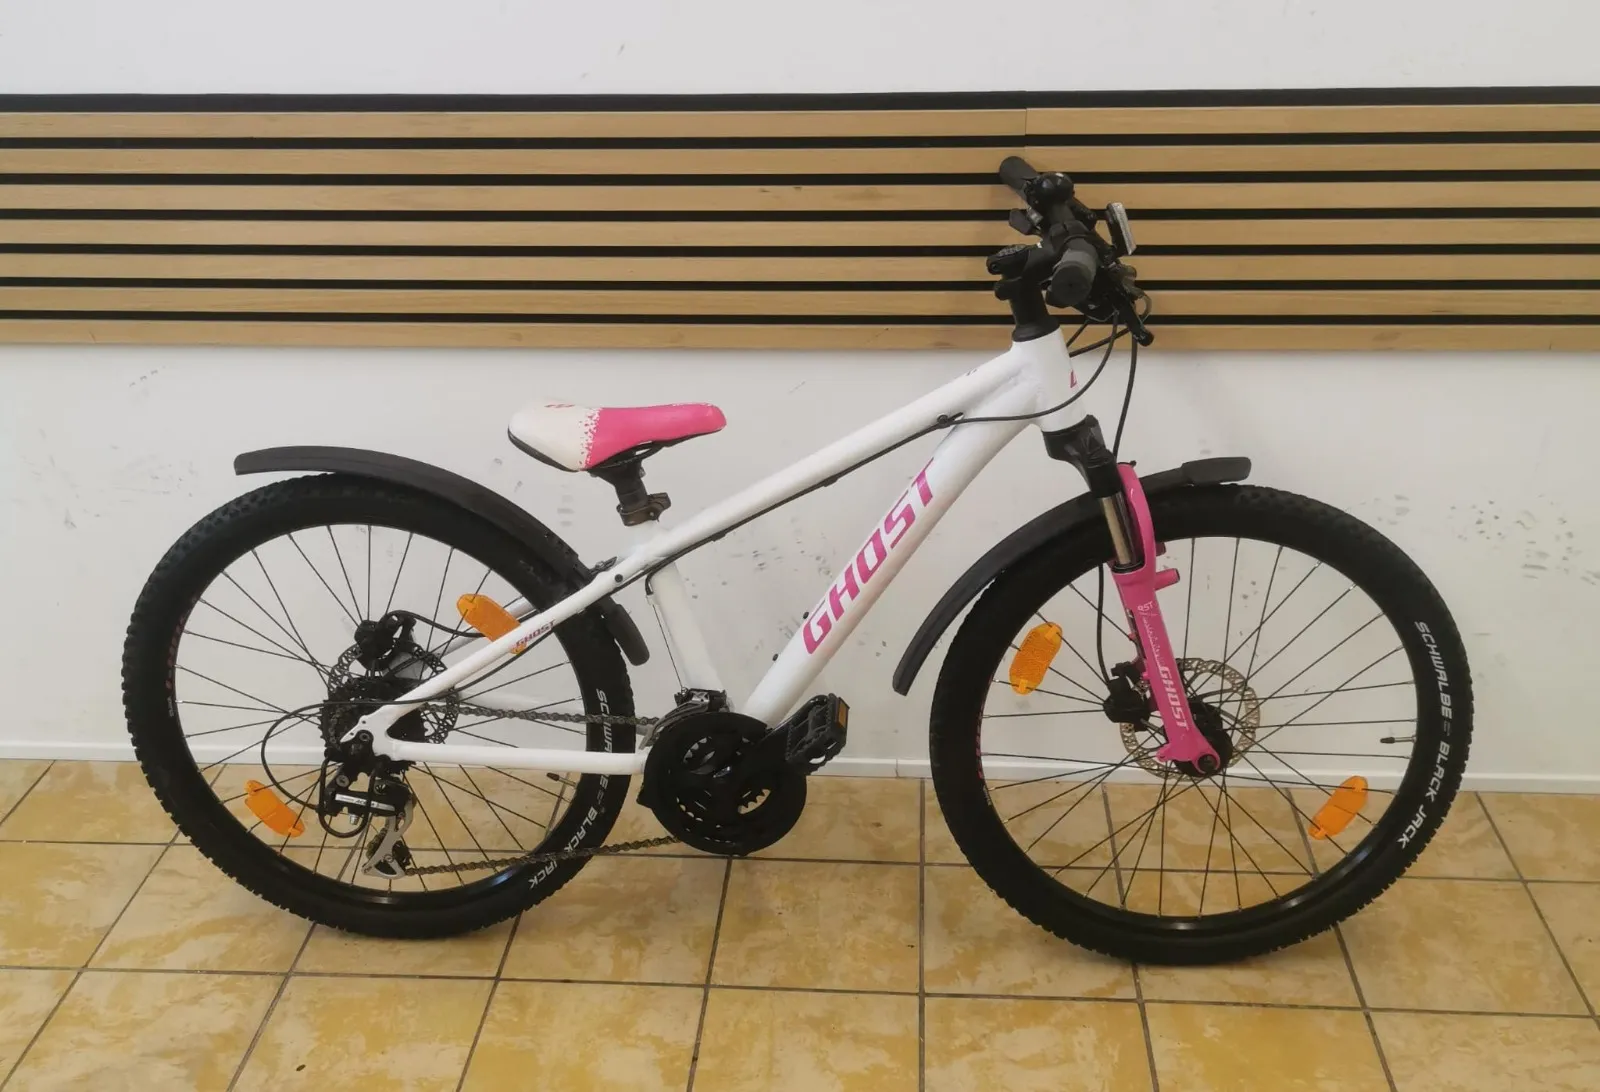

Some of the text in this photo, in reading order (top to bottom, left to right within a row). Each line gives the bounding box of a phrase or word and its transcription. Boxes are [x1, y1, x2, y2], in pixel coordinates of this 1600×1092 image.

[803, 456, 934, 654] GHOST
[517, 619, 555, 646] GHOST
[1161, 666, 1189, 730] GHOST
[1397, 620, 1452, 849] SCHWALBE BLACK JACK
